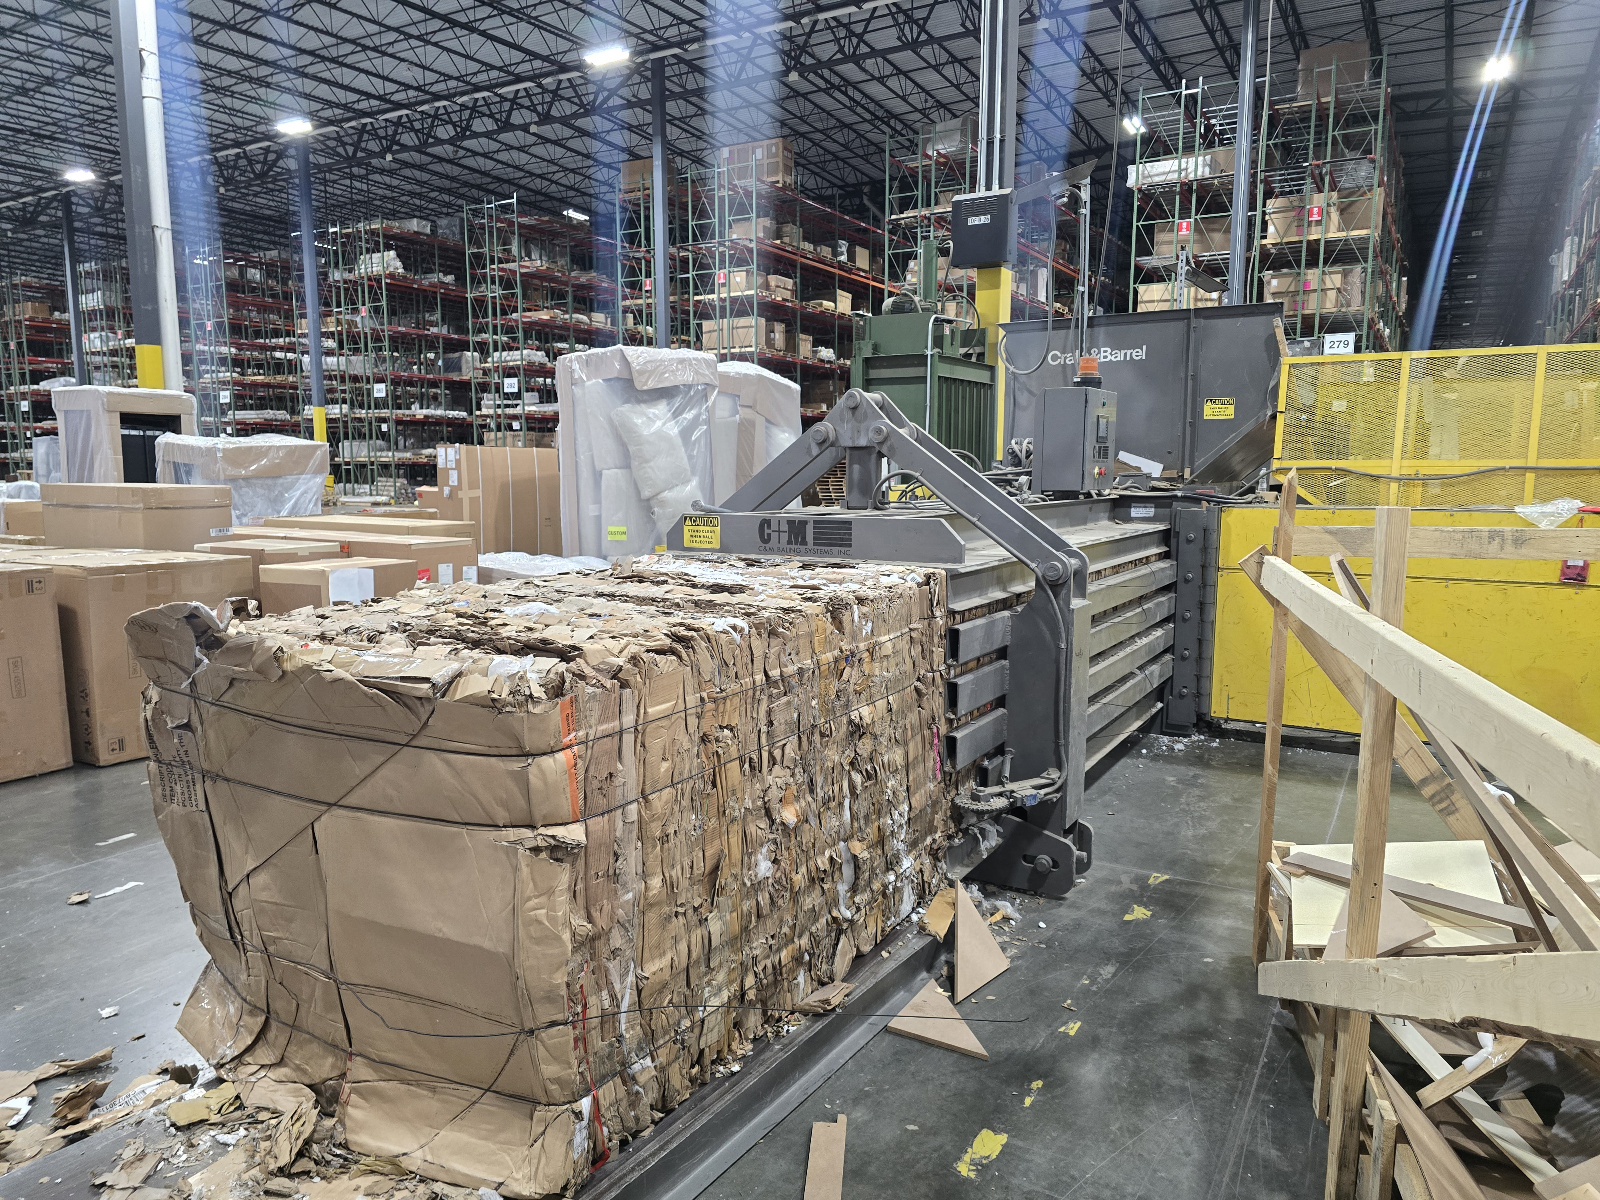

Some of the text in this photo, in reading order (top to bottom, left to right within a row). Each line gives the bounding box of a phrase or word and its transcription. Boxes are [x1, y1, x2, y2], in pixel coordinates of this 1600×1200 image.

[1328, 339, 1350, 349] 279
[691, 516, 718, 527] CAUTION
[805, 548, 834, 556] SYSTEMS
[838, 549, 853, 557] INC.
